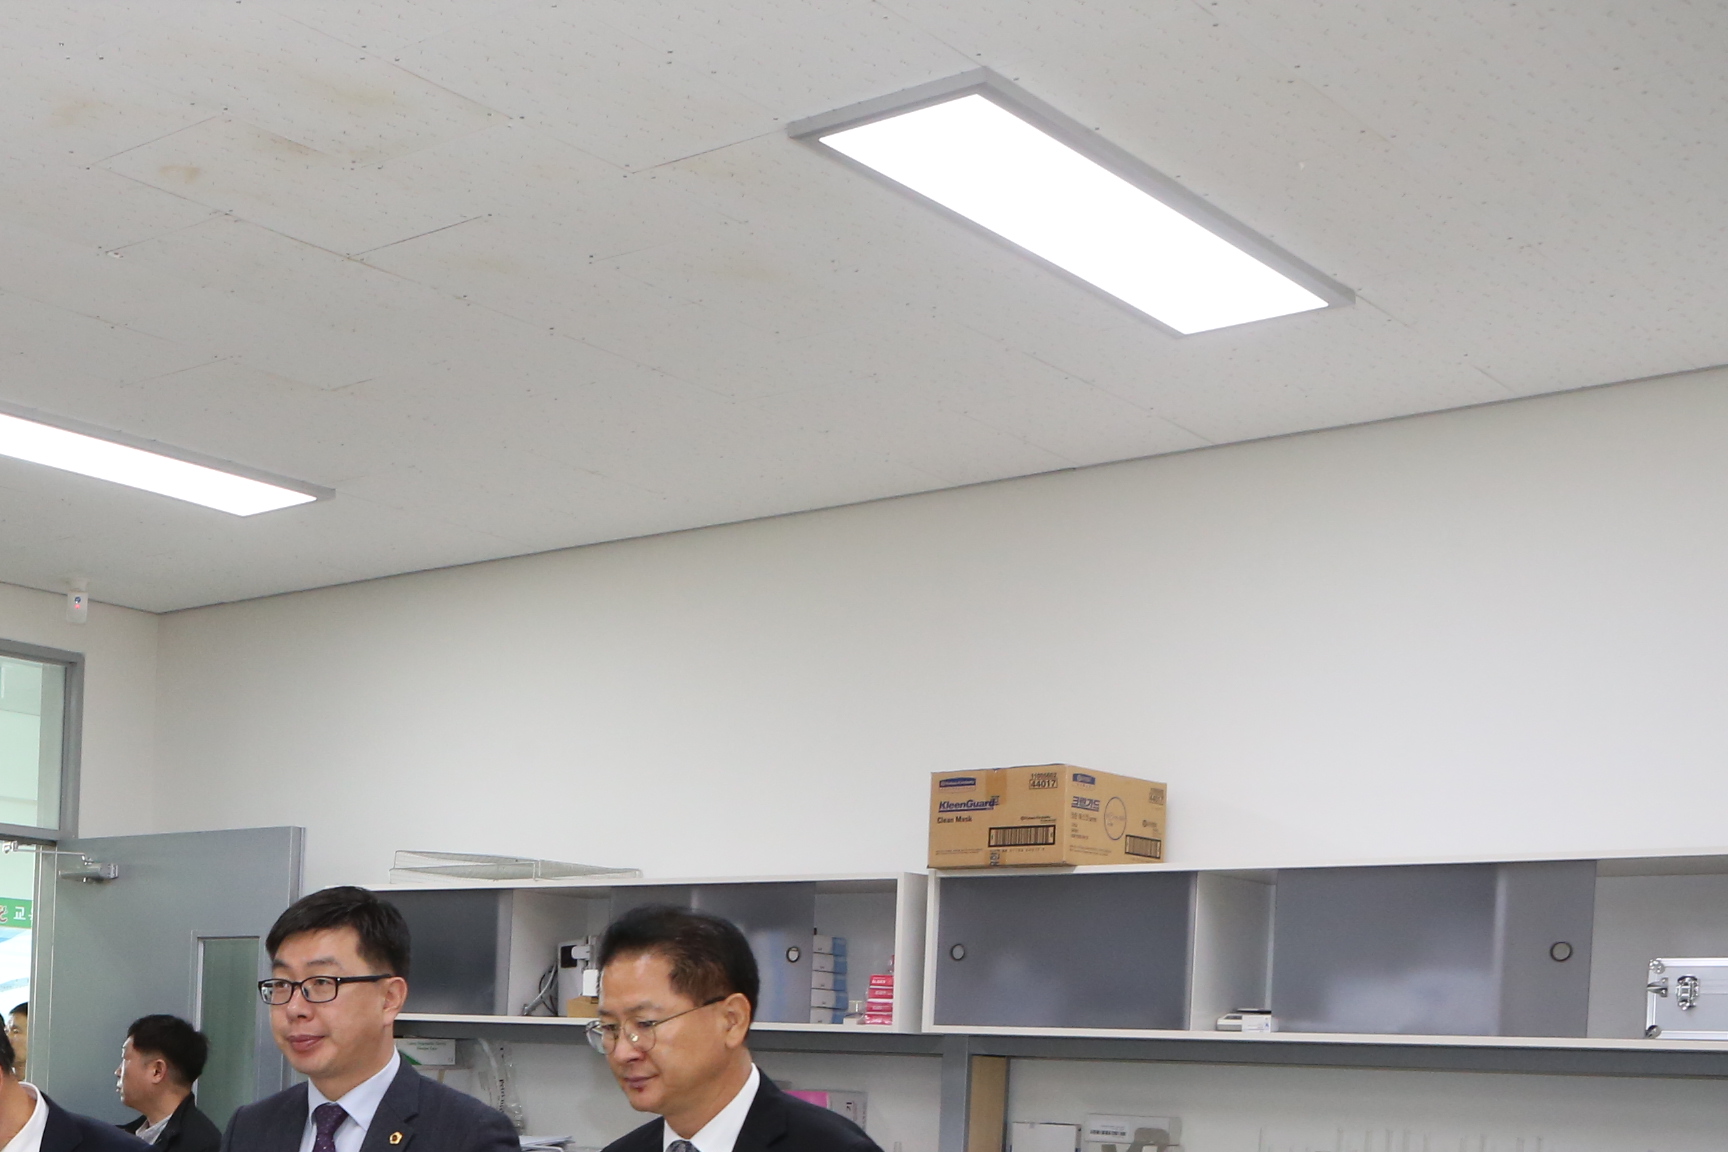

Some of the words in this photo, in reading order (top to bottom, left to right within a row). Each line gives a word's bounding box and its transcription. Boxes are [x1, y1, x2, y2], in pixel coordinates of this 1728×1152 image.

[1030, 780, 1057, 788] 44017
[939, 799, 995, 810] KleenGuard
[955, 815, 972, 823] Mask
